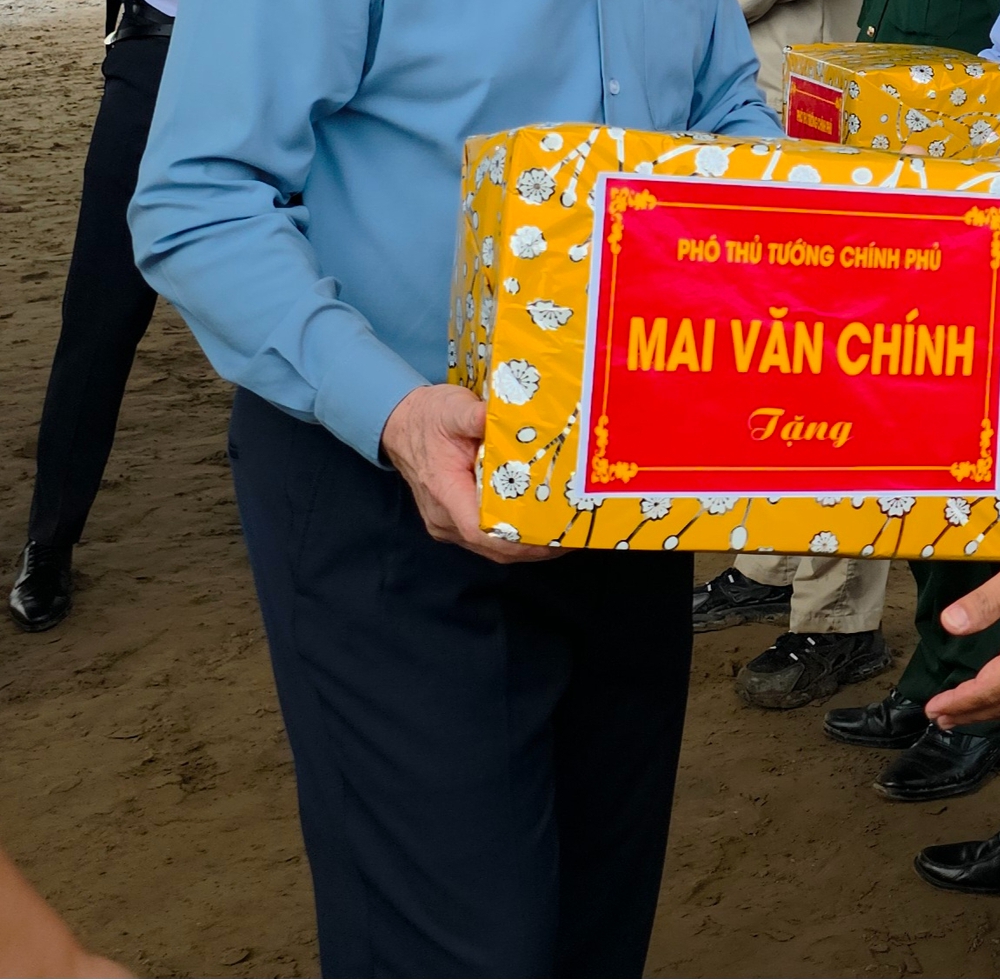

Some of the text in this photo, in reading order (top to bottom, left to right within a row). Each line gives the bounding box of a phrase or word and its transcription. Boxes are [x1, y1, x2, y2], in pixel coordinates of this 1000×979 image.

[676, 234, 942, 271] PHÓ THỦ TƯỚNG CHÍNH PHỦ
[626, 306, 976, 377] MAI VĂN CHÍNH
[747, 407, 854, 449] Tặng
